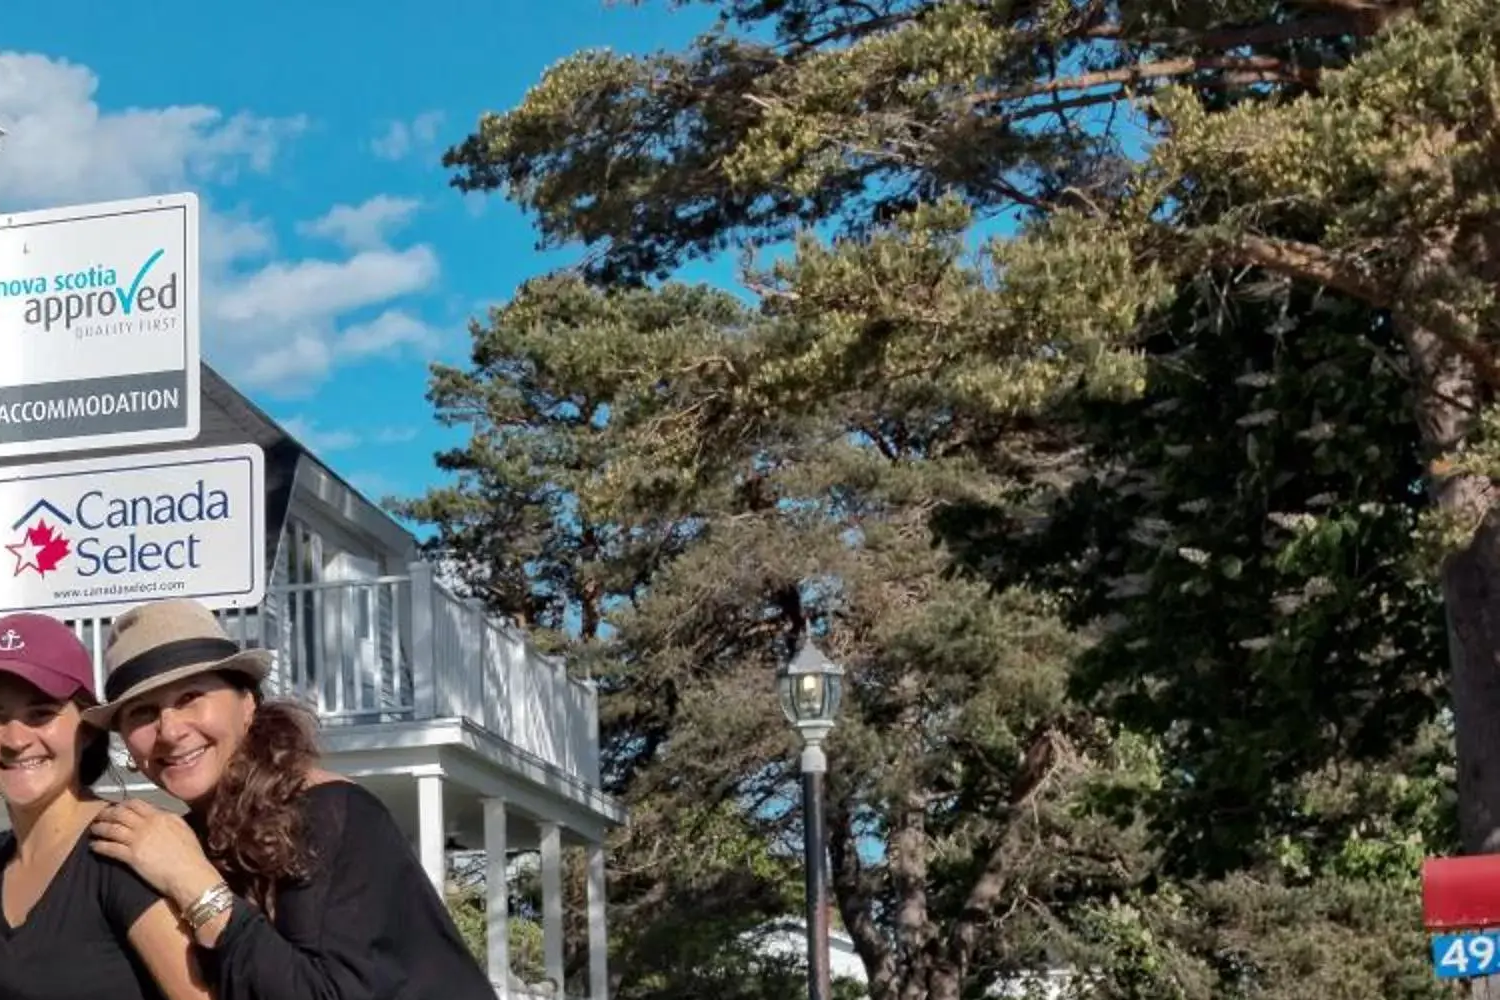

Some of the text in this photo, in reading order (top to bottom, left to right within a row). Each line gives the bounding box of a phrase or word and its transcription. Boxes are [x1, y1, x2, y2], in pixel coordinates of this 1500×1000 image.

[24, 249, 178, 332] approved
[54, 264, 117, 291] scotia
[75, 316, 178, 340] QUALITY FIRST
[75, 480, 230, 530] Canada
[76, 533, 202, 577] Select
[52, 580, 186, 600] www.canadaselect.com
[1440, 935, 1500, 974] 49
